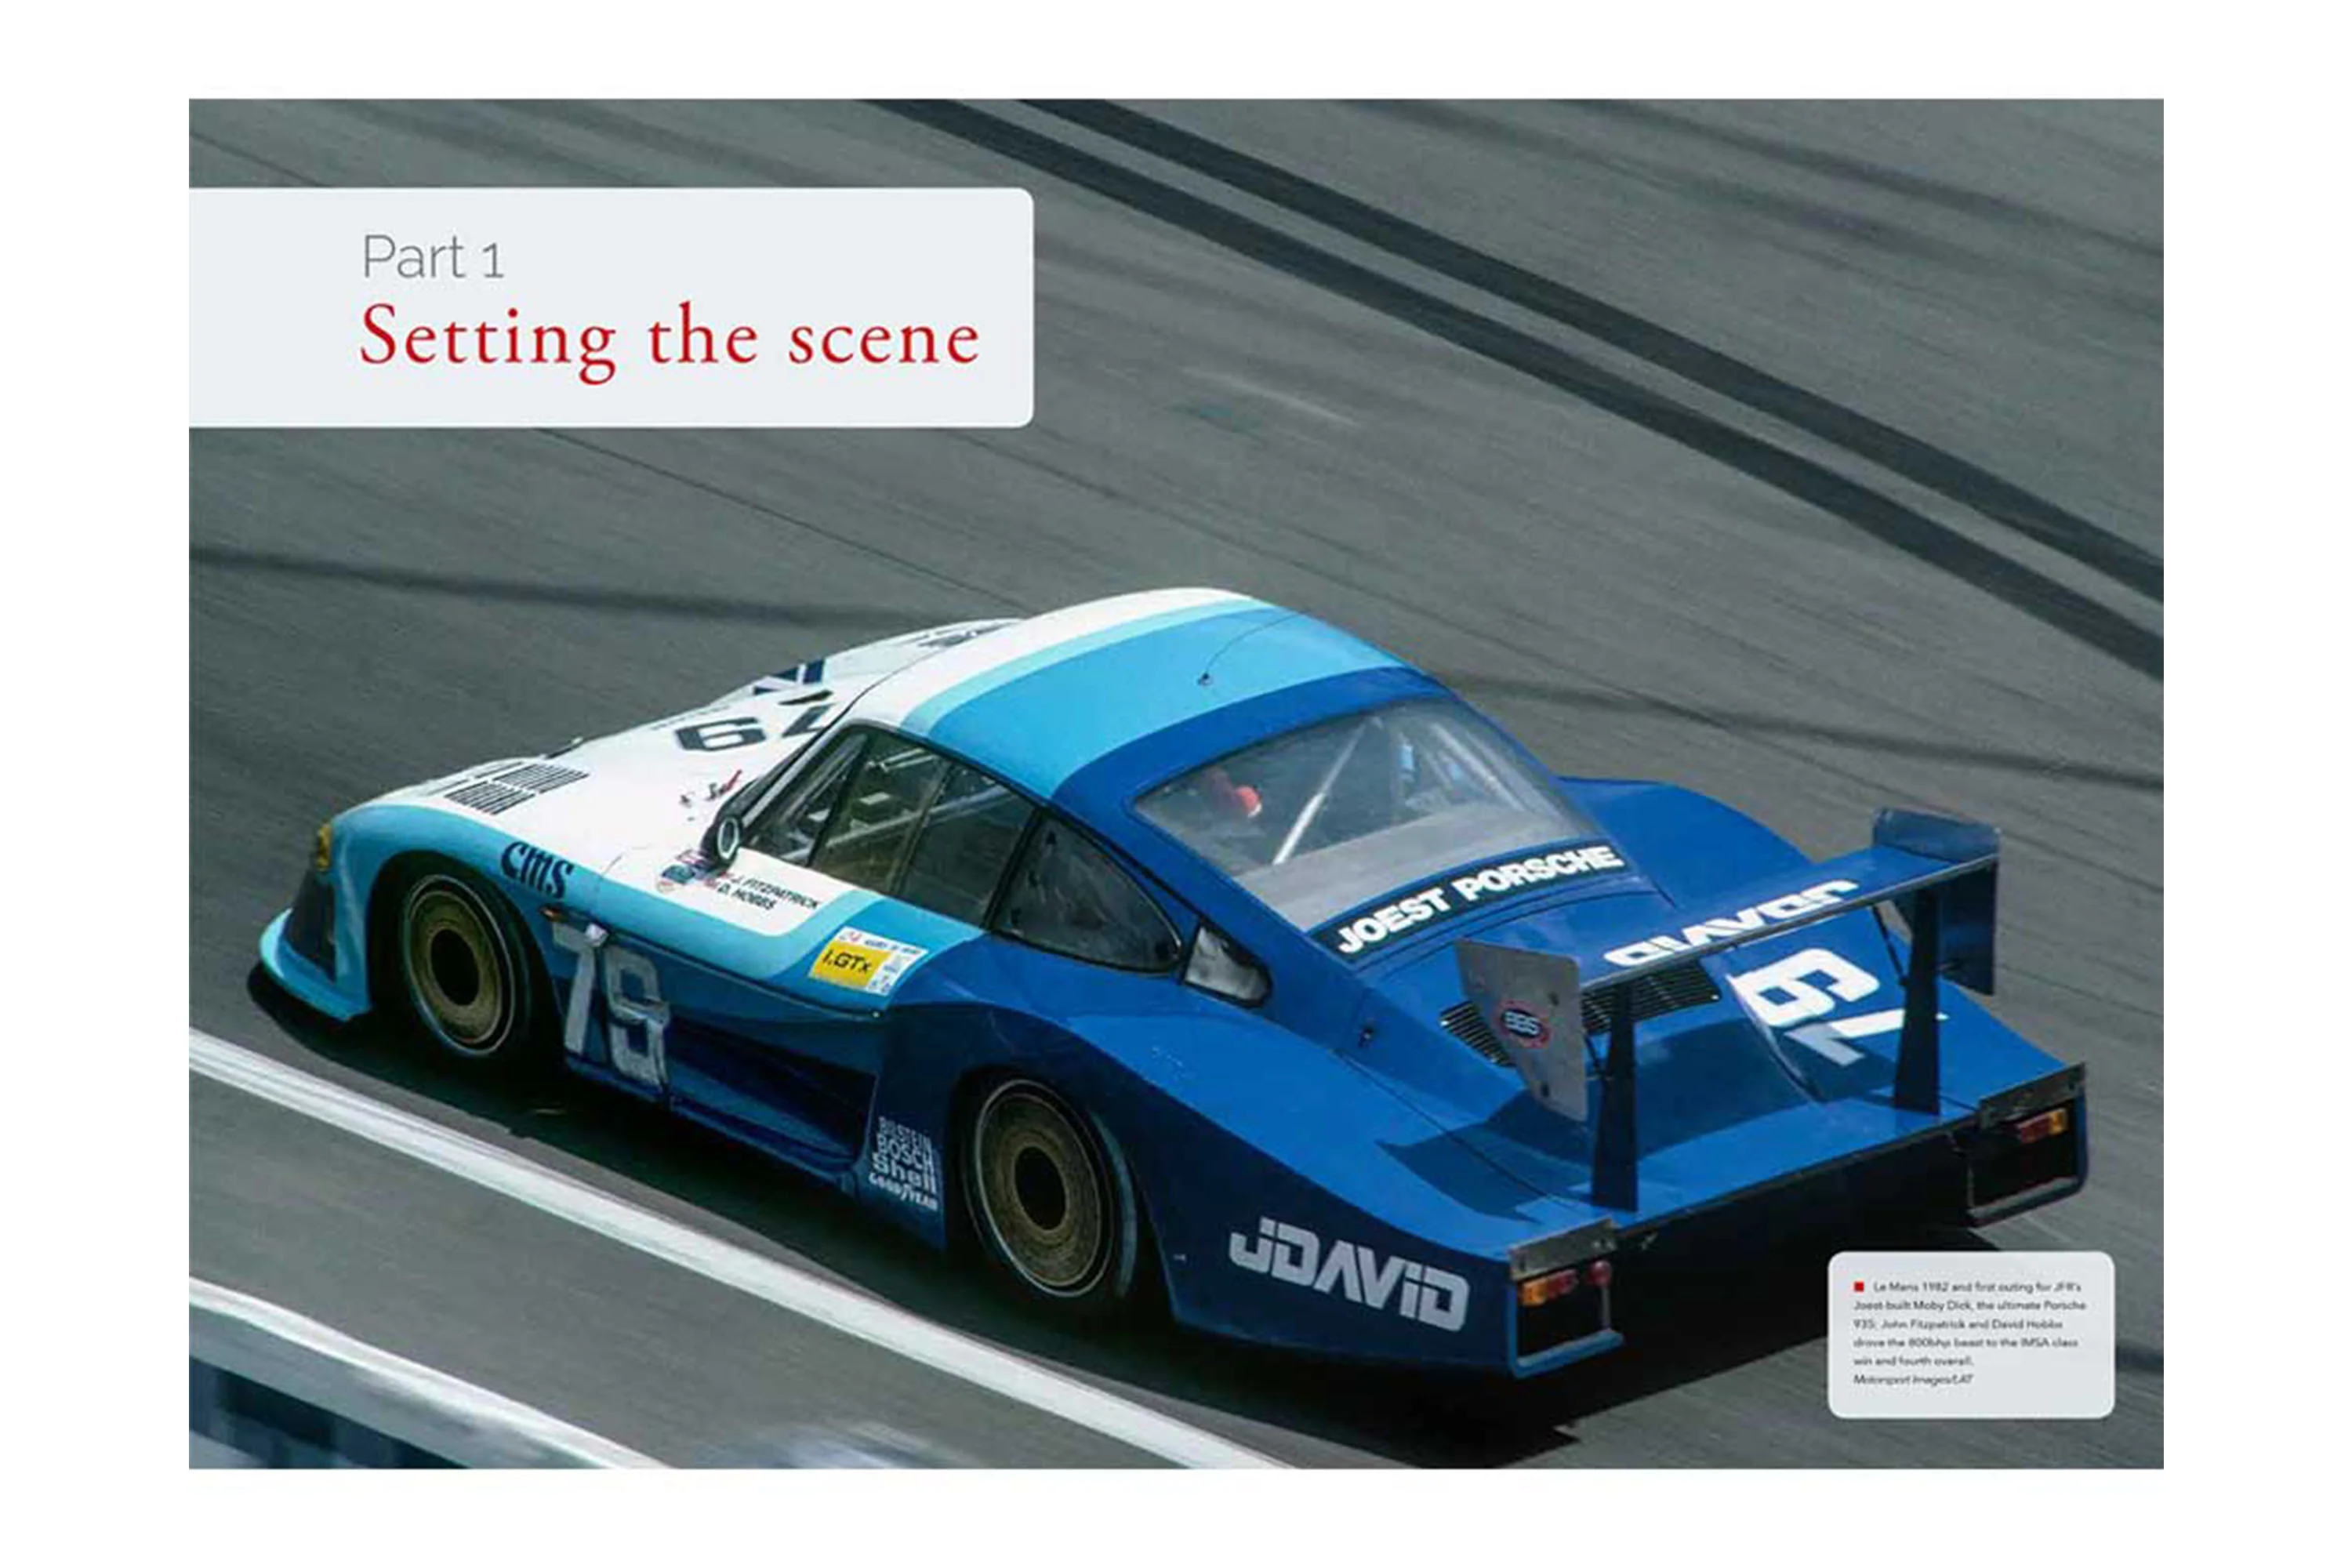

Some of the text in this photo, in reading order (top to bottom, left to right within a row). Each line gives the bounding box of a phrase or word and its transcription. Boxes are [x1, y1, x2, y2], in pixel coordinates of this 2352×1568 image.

[732, 889, 776, 909] HOBBS
[743, 878, 819, 909] FITZPATRICK
[1338, 844, 1625, 954] JOEST PORSCHE
[872, 1152, 937, 1195] Shell
